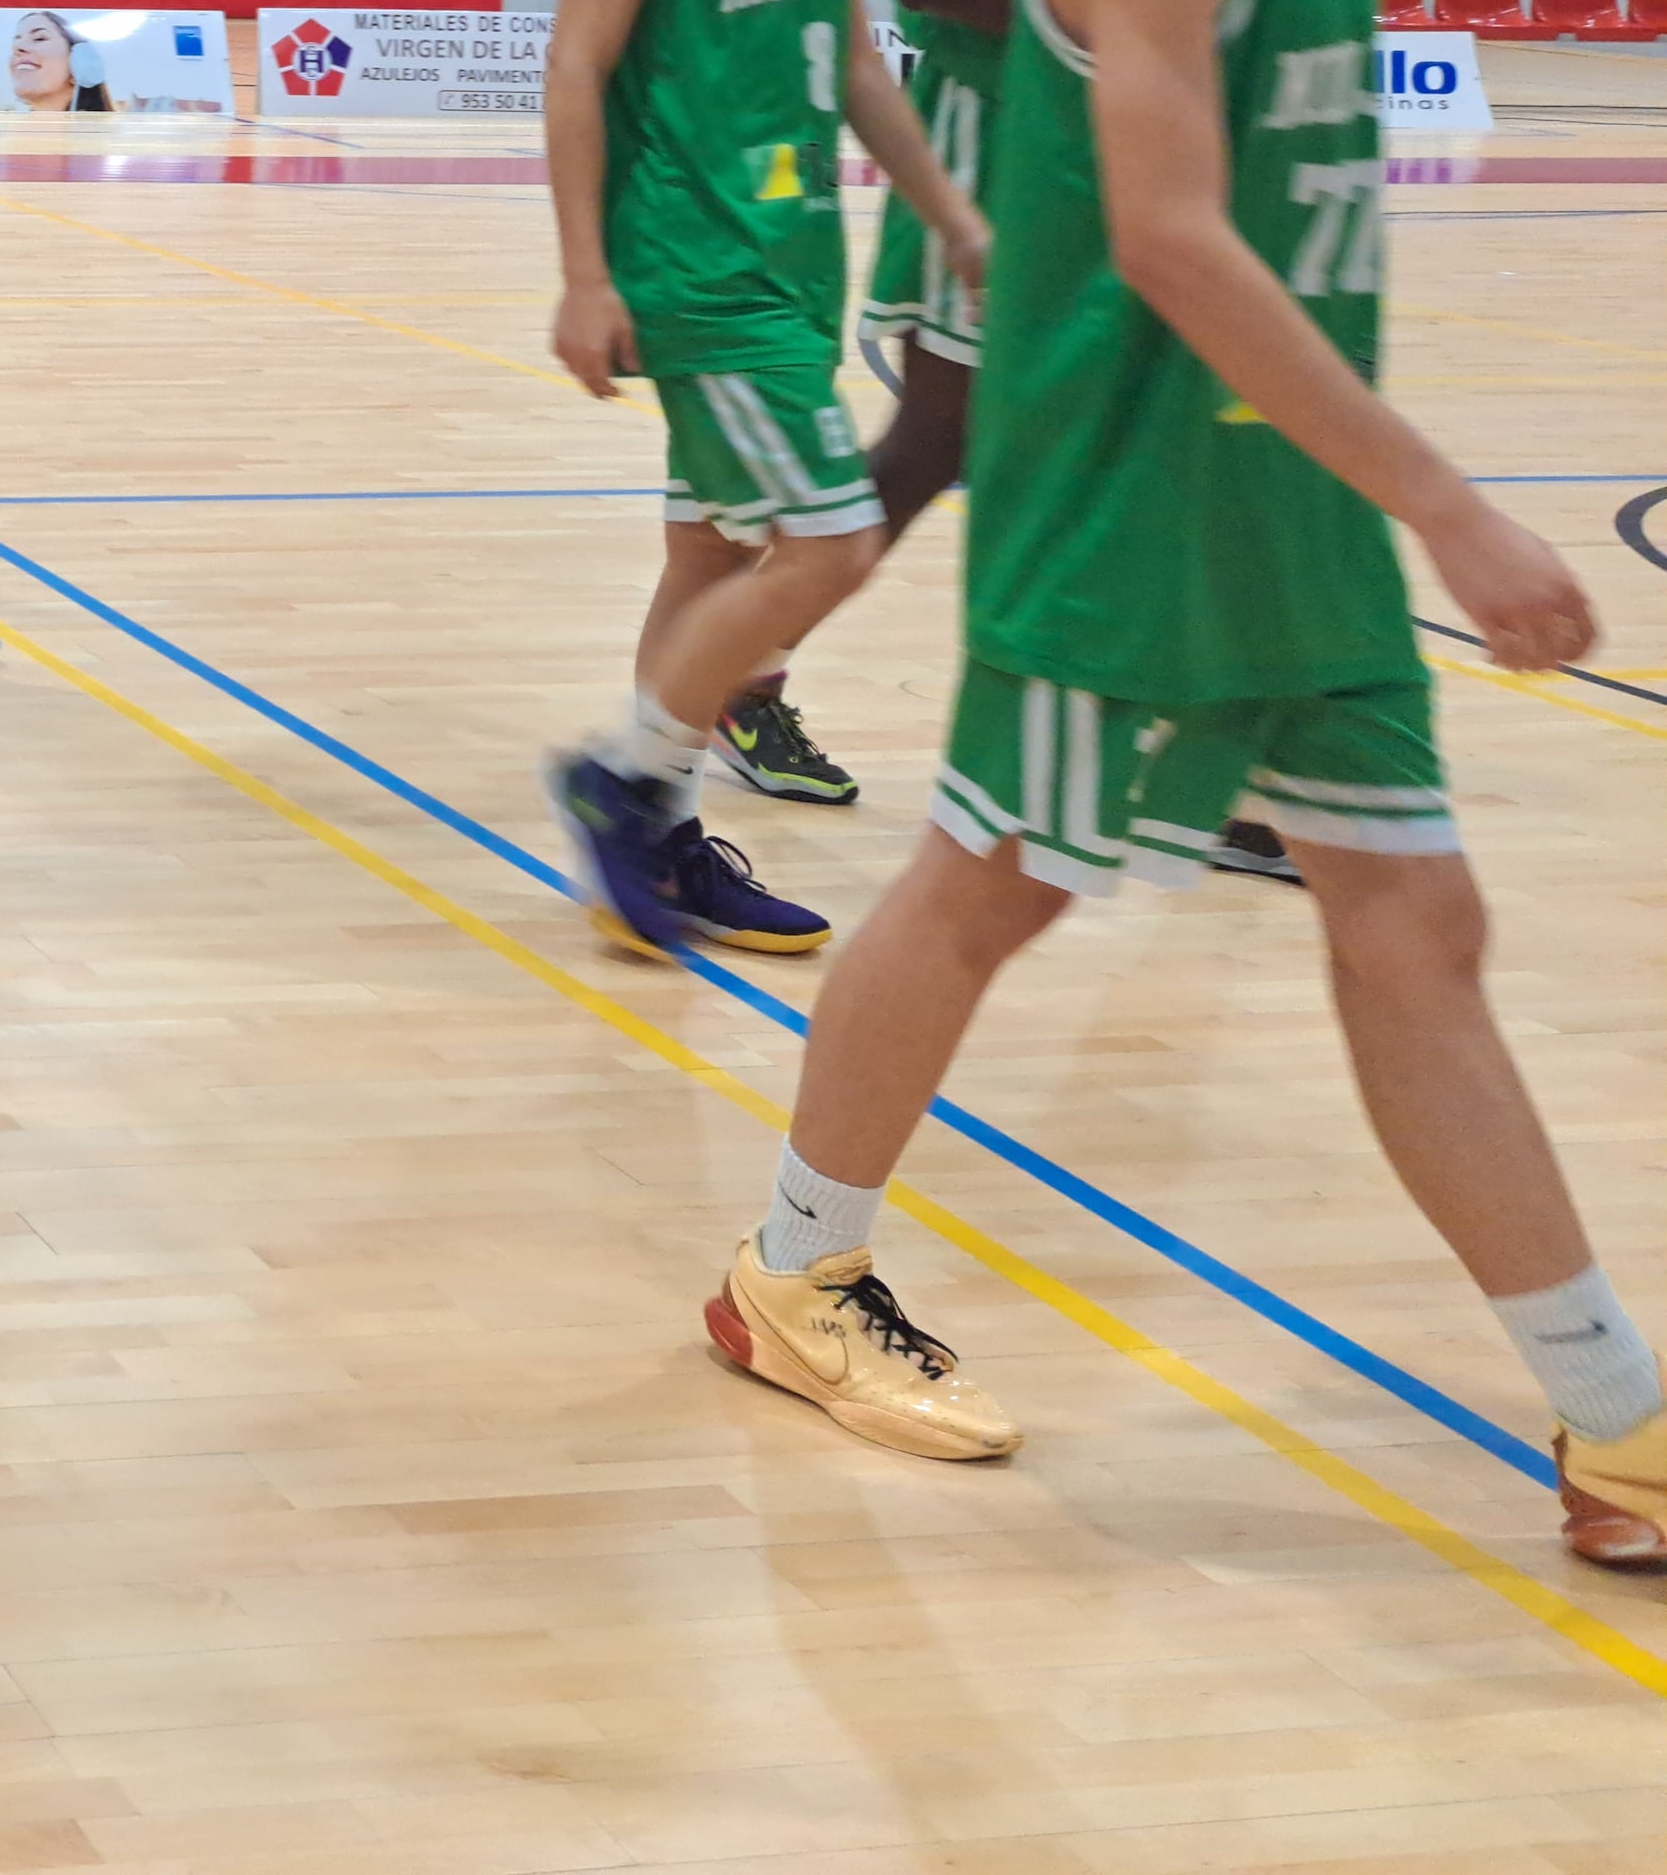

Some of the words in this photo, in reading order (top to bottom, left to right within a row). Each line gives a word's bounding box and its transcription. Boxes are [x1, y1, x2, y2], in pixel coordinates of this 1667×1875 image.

[354, 14, 468, 32] MATERIALES
[478, 16, 502, 33] DE
[376, 39, 463, 59] VIRGEN
[473, 40, 503, 59] DE
[510, 41, 537, 60] LA
[361, 67, 440, 82] AZULEJOS
[461, 93, 489, 109] 953
[495, 94, 514, 109] 50
[518, 95, 537, 110] 41
